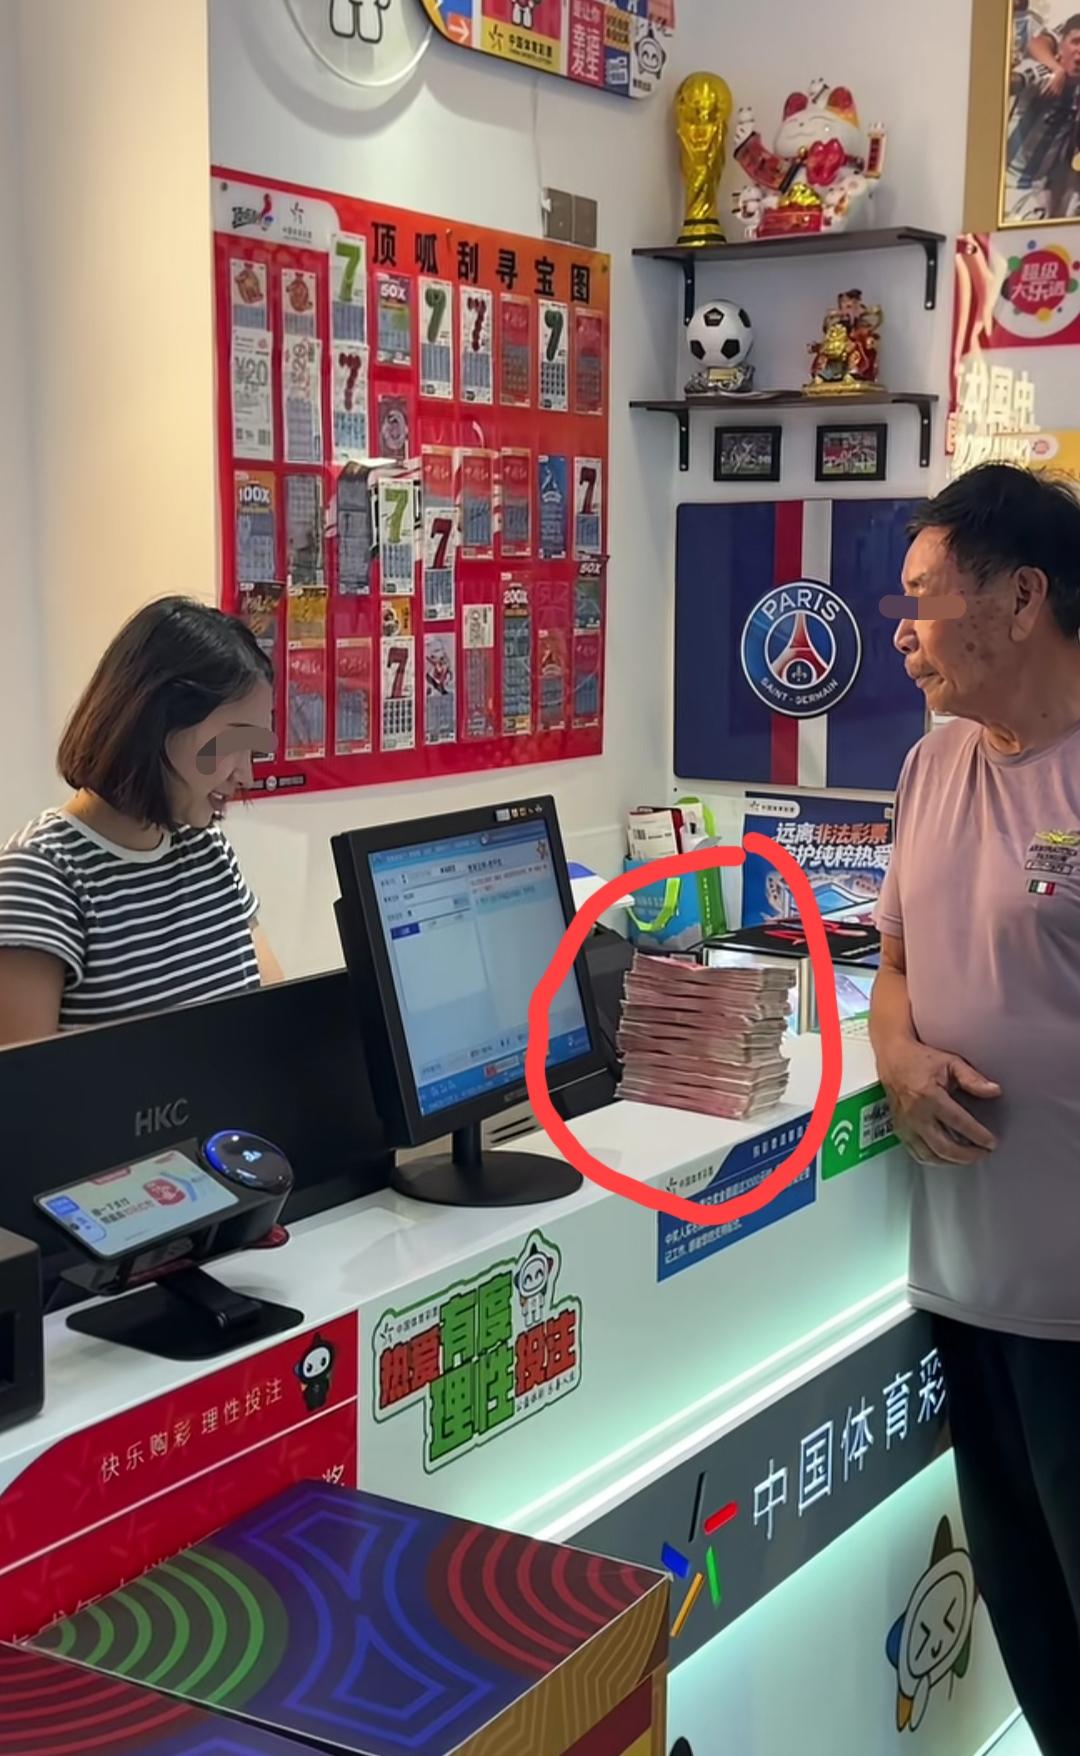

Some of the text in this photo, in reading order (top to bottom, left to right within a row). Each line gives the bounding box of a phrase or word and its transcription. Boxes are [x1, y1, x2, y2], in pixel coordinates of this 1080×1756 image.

[371, 221, 590, 304] 顶呱刮寻宝图
[1021, 261, 1059, 281] 超级
[579, 467, 597, 514] 7
[385, 488, 408, 543] 7
[431, 518, 453, 569] 7
[761, 589, 841, 622] PARIS
[387, 647, 409, 699] 7
[776, 822, 889, 844] 远离非法彩票
[134, 1099, 190, 1137] HKC
[101, 1378, 283, 1483] 快乐购彩 理性投注
